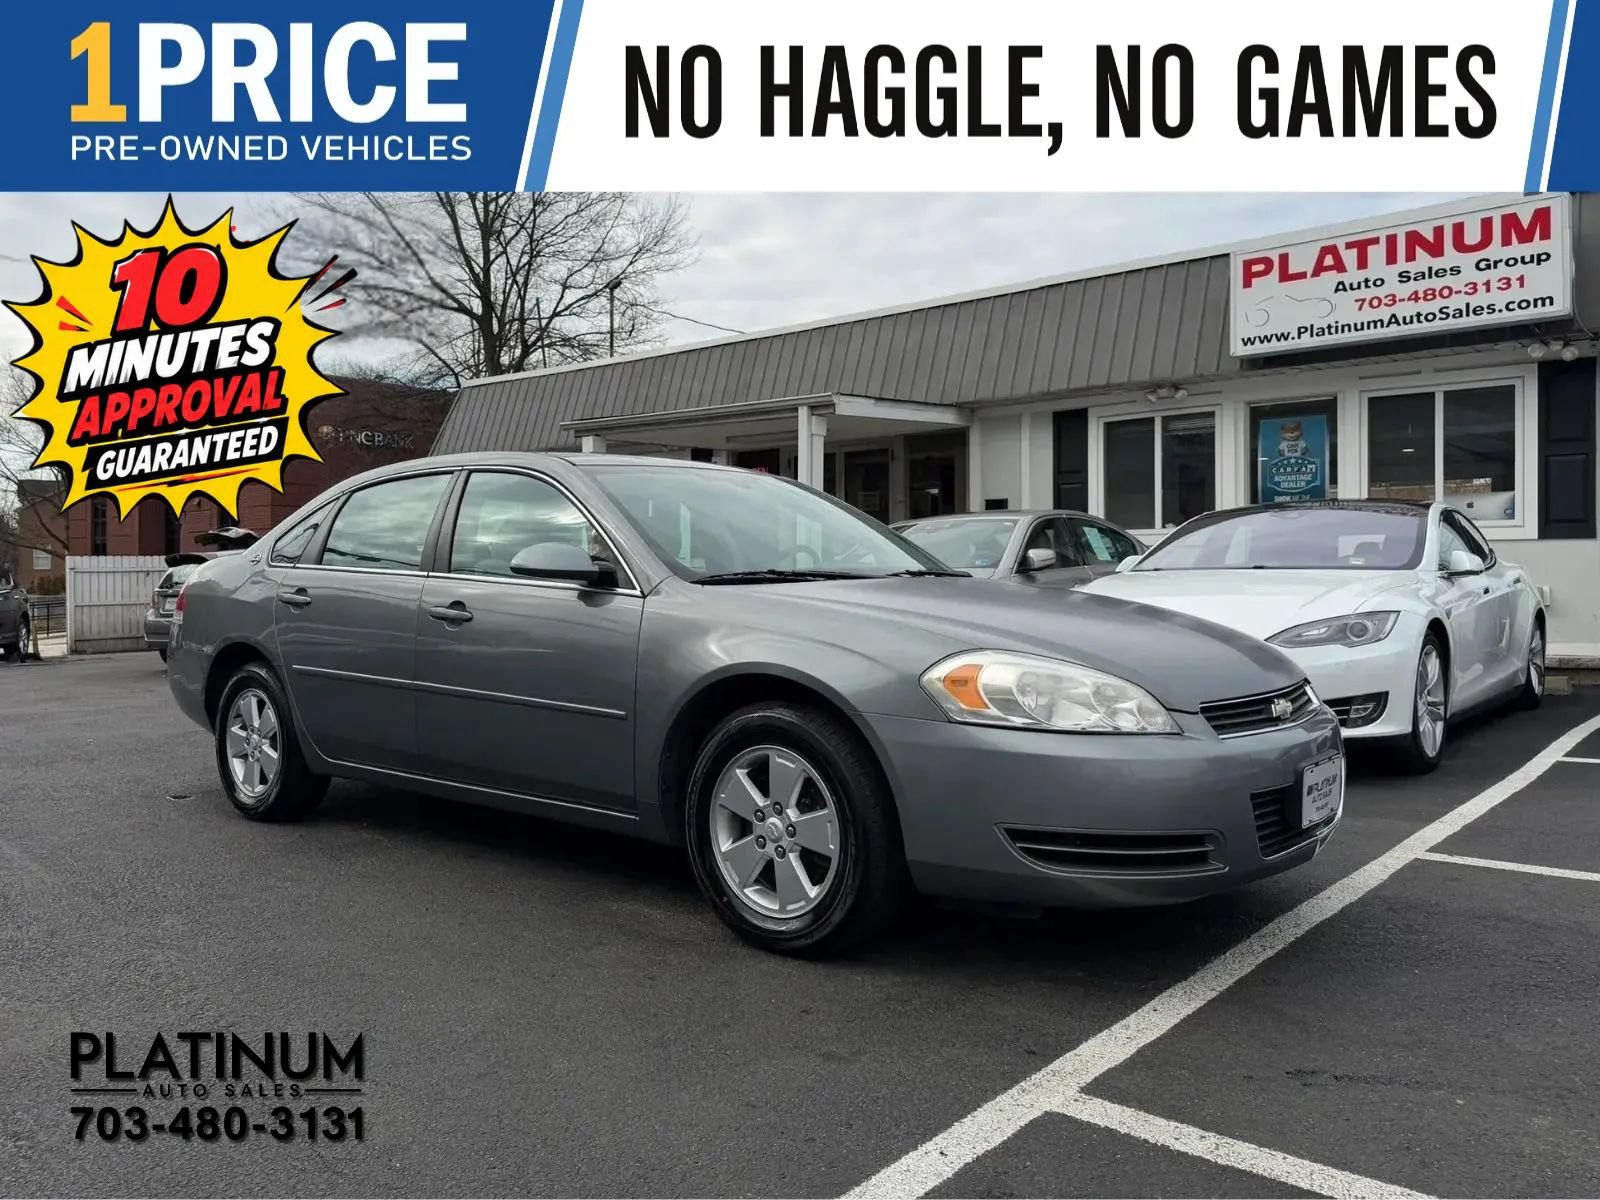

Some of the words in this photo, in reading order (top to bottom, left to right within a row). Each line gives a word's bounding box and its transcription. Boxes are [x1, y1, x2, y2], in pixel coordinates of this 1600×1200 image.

[1242, 206, 1551, 289] PLATINUM
[1334, 275, 1385, 294] Auto
[1397, 264, 1461, 284] Sales
[1474, 251, 1551, 272] Group
[1354, 274, 1526, 312] 703-480-3131
[1241, 294, 1554, 348] www.PlatinumAutoSales.com
[1274, 474, 1312, 482] ADVANTAGE
